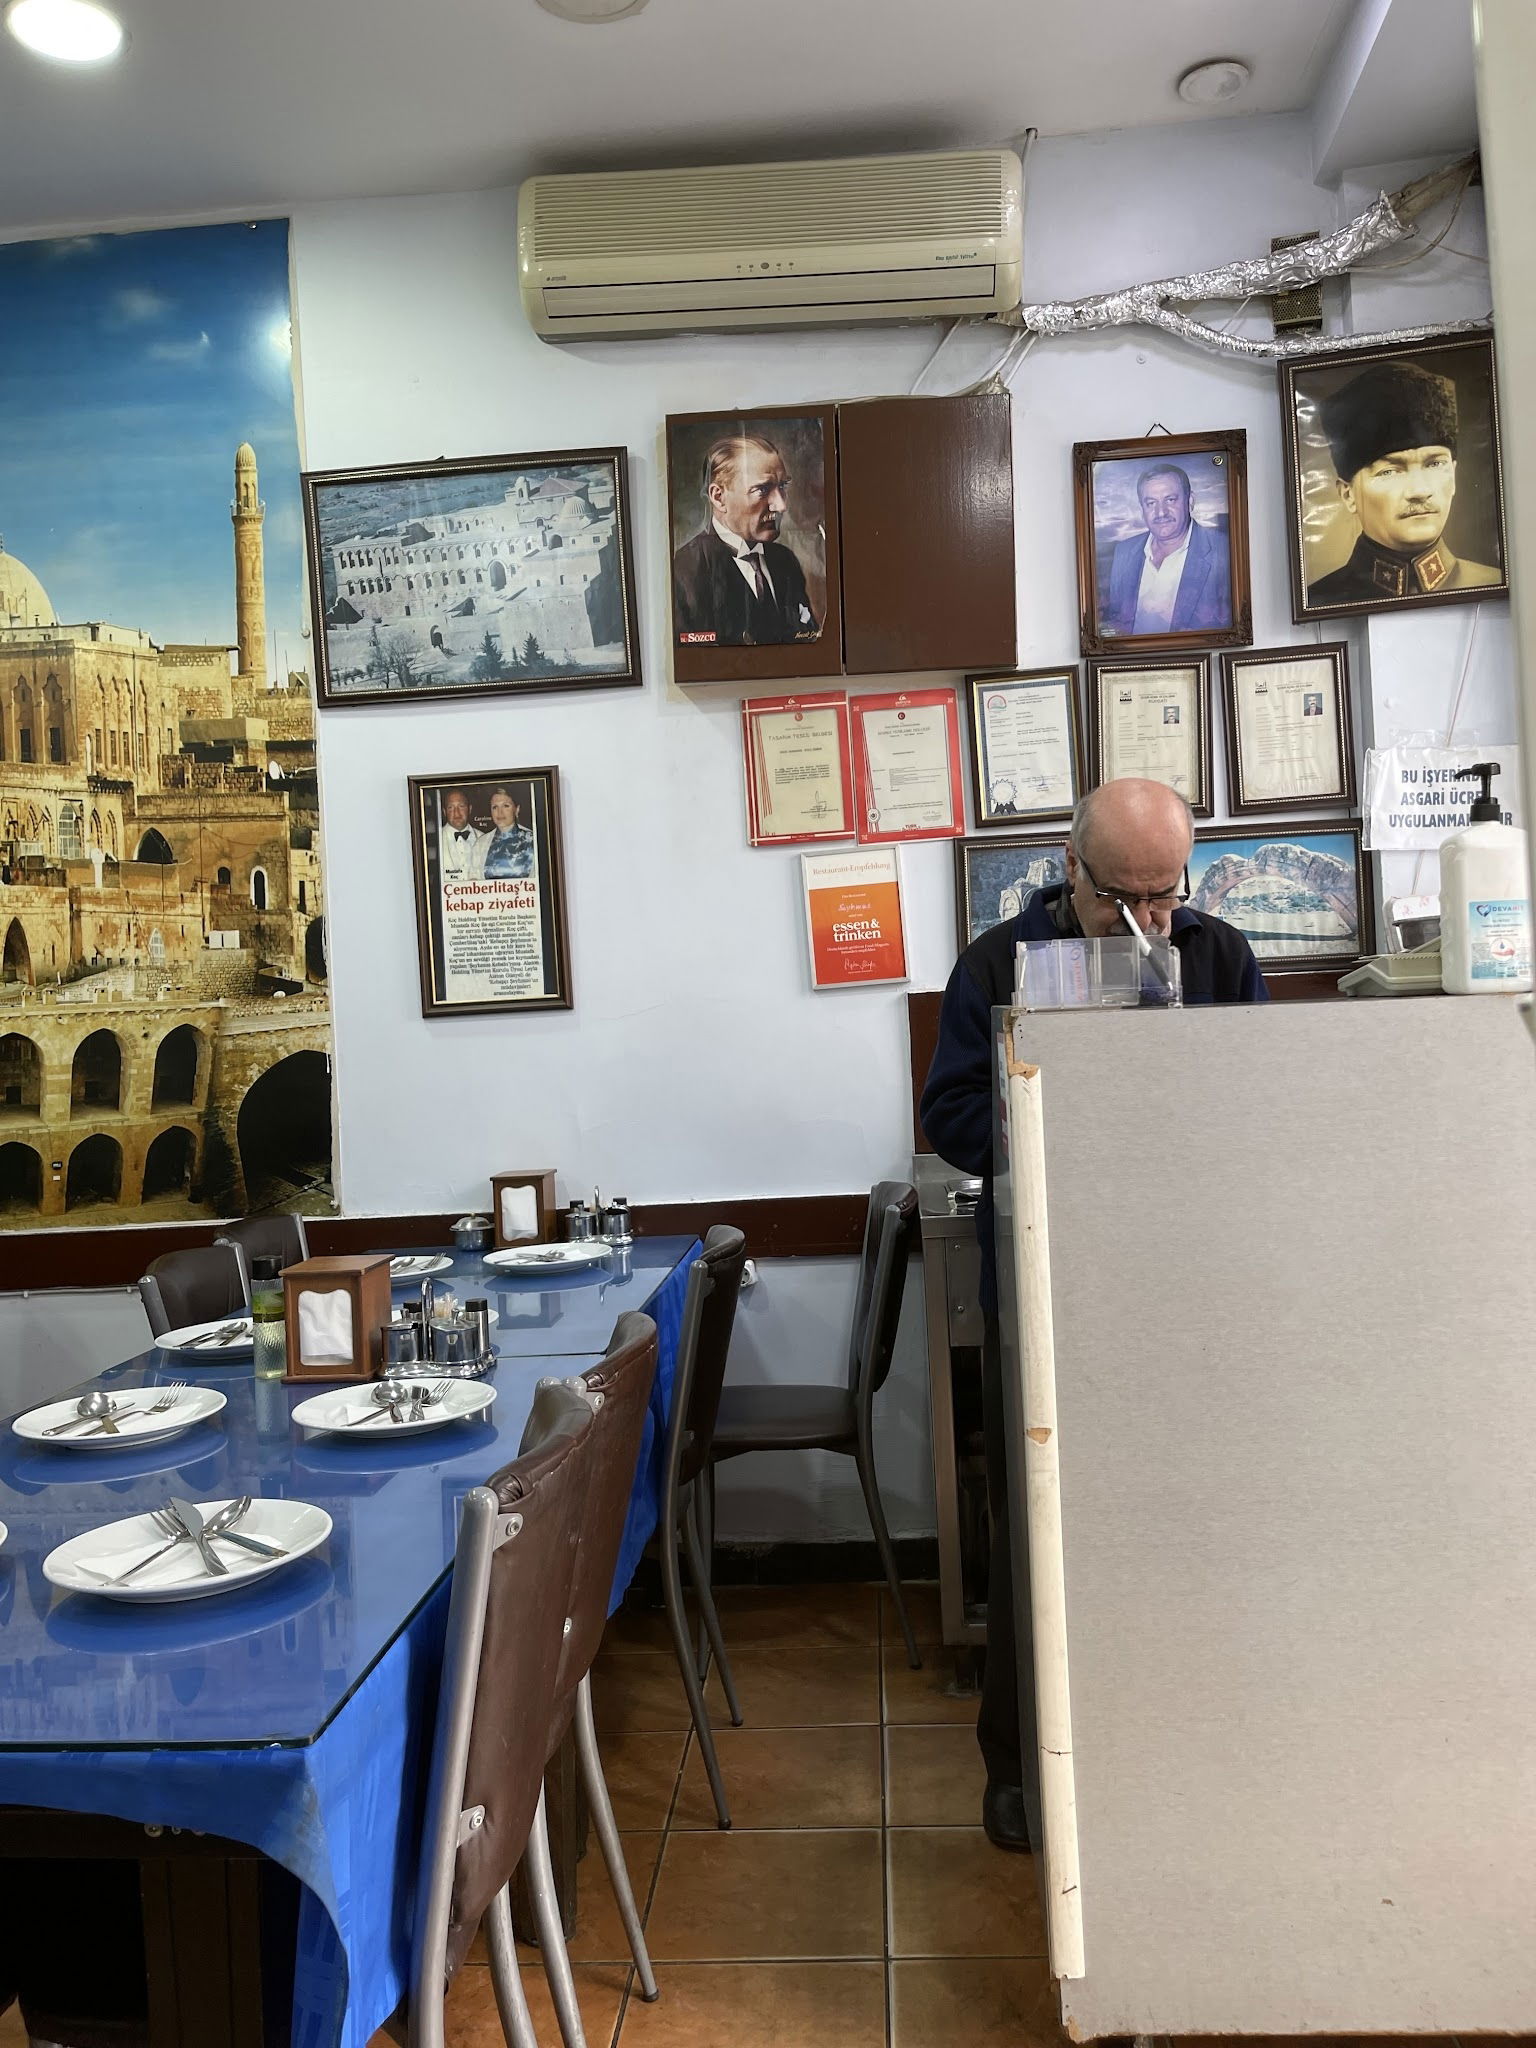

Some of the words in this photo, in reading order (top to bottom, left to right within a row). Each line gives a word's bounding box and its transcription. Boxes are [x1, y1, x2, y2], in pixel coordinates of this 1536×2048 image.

[1401, 770, 1418, 784] BU
[1422, 765, 1481, 787] İŞYERİND
[1401, 787, 1445, 806] ASGARİ
[443, 881, 536, 898] Çemberlitaş'ta
[446, 898, 484, 914] kebap
[488, 896, 535, 912] ziyafeti
[834, 930, 882, 942] trinken
